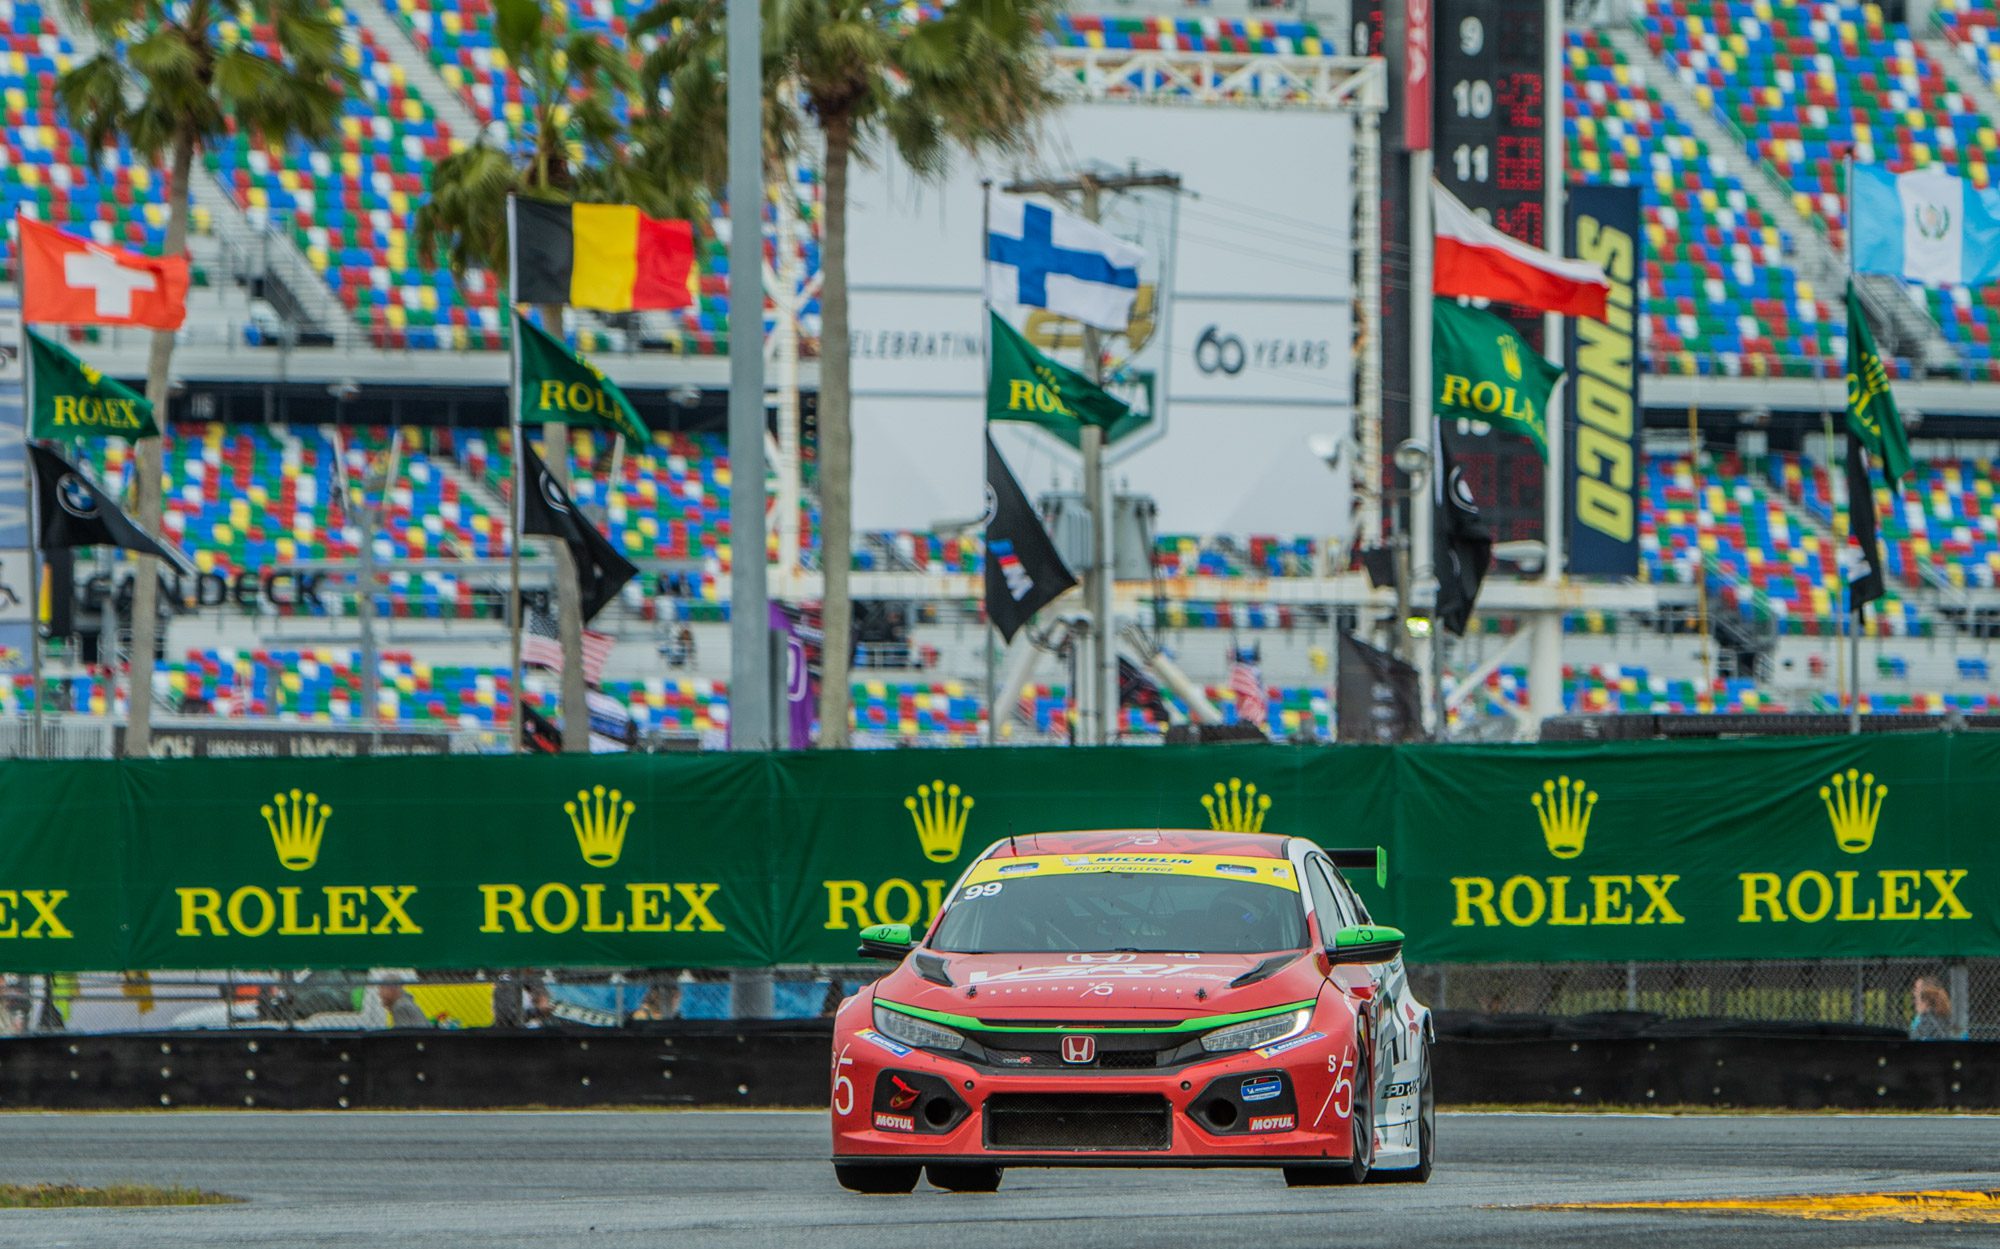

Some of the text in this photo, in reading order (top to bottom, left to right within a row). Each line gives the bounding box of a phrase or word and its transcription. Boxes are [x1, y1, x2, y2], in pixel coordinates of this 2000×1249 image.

[1459, 15, 1484, 56] 9
[1453, 79, 1492, 119] 10
[1453, 143, 1489, 182] 11
[848, 329, 985, 358] ELEBRATIN
[1195, 323, 1329, 375] 60 YEARS
[479, 882, 726, 933] ROLEX
[964, 882, 1003, 900] 99
[1450, 875, 1685, 926] ROLEX
[1738, 870, 1973, 923] ROLEX
[175, 886, 422, 937] ROLEX
[876, 1115, 912, 1129] MOTUL
[1251, 1117, 1293, 1130] MOTUL
